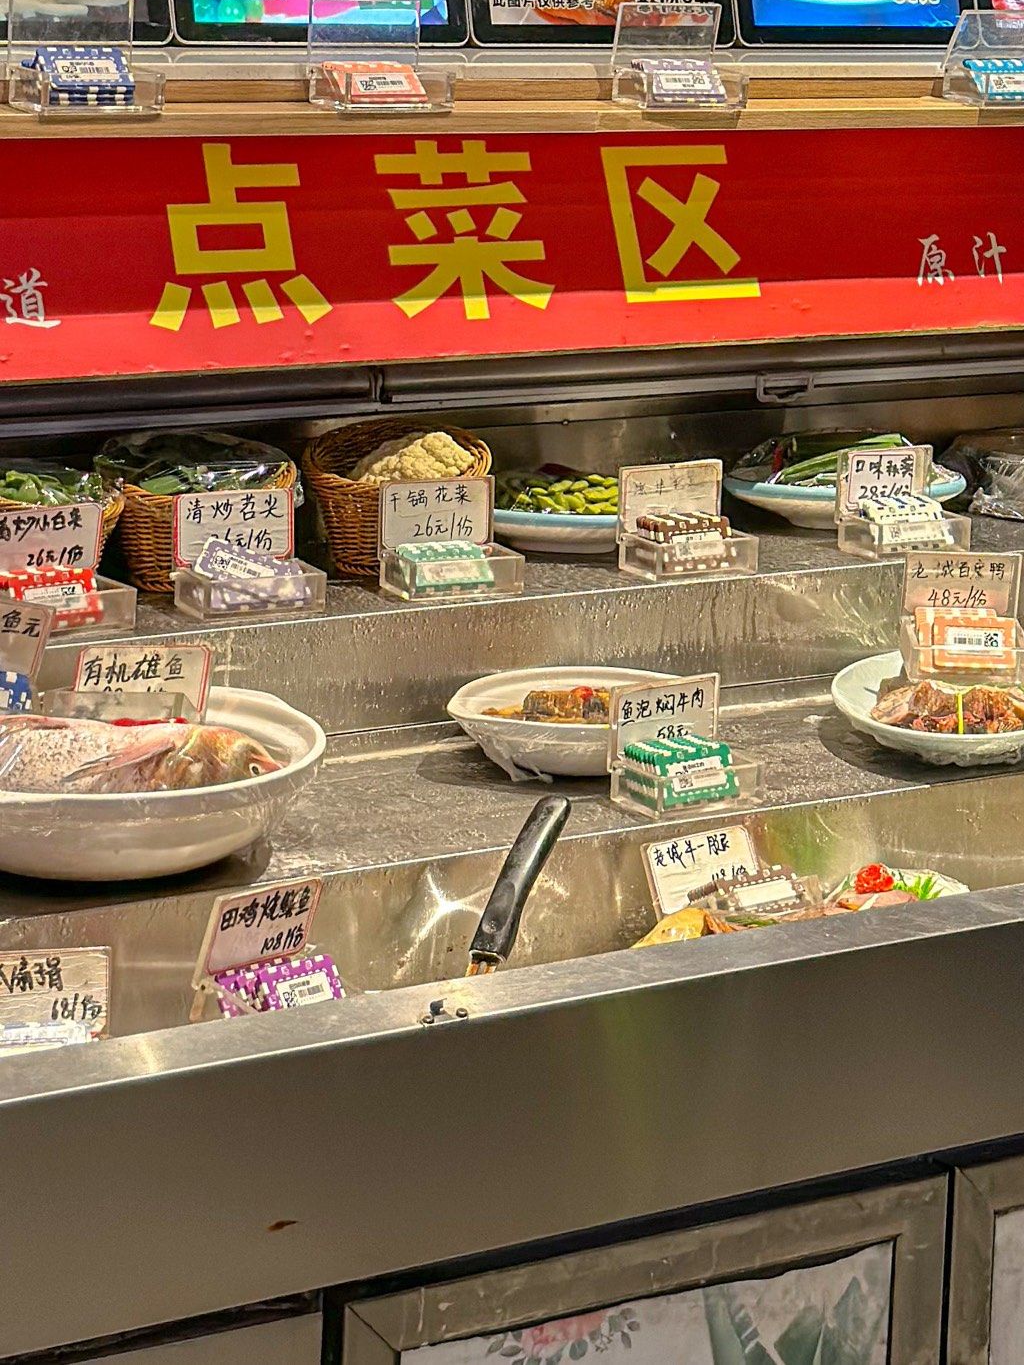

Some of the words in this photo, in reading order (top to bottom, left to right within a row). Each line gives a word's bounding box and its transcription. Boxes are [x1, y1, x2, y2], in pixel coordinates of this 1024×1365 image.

[150, 140, 761, 331] 点菜区
[0, 267, 61, 329] 道
[186, 493, 284, 524] 清炒苕尖
[391, 484, 471, 512] 干锅花菜
[413, 513, 473, 539] 26元/份
[928, 585, 987, 608] 48元/份
[84, 653, 185, 685] 有机雄鱼
[621, 687, 704, 726] 鱼泡焖牛肉
[261, 924, 304, 954] 108/份
